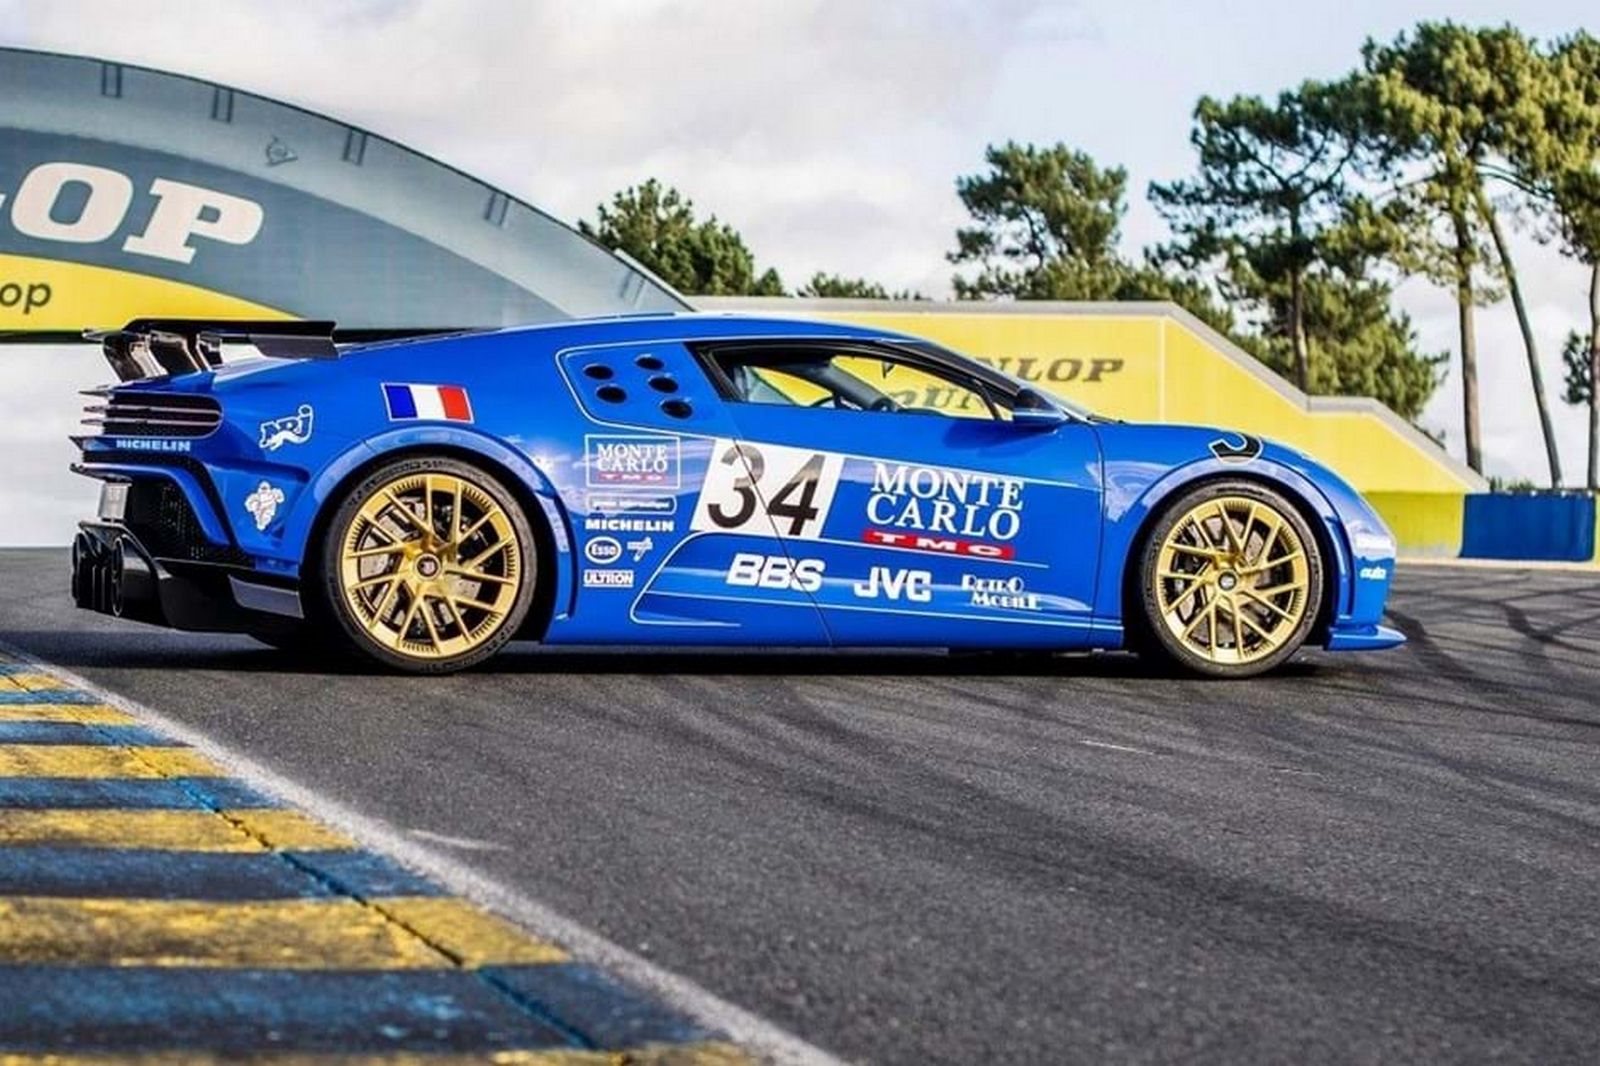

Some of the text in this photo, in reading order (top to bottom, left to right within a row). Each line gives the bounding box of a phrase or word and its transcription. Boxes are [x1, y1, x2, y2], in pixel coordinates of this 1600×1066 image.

[0, 161, 264, 264] OP
[116, 439, 191, 452] MICHELIN
[597, 443, 668, 460] MONTE
[597, 457, 668, 473] CARLO
[707, 443, 826, 536] 34
[870, 461, 1025, 511] MONTE
[585, 519, 674, 532] MICHELIN
[866, 494, 1021, 540] CARLO
[872, 531, 1004, 556] TMC
[726, 553, 826, 592] BBS
[854, 567, 932, 601] JVC
